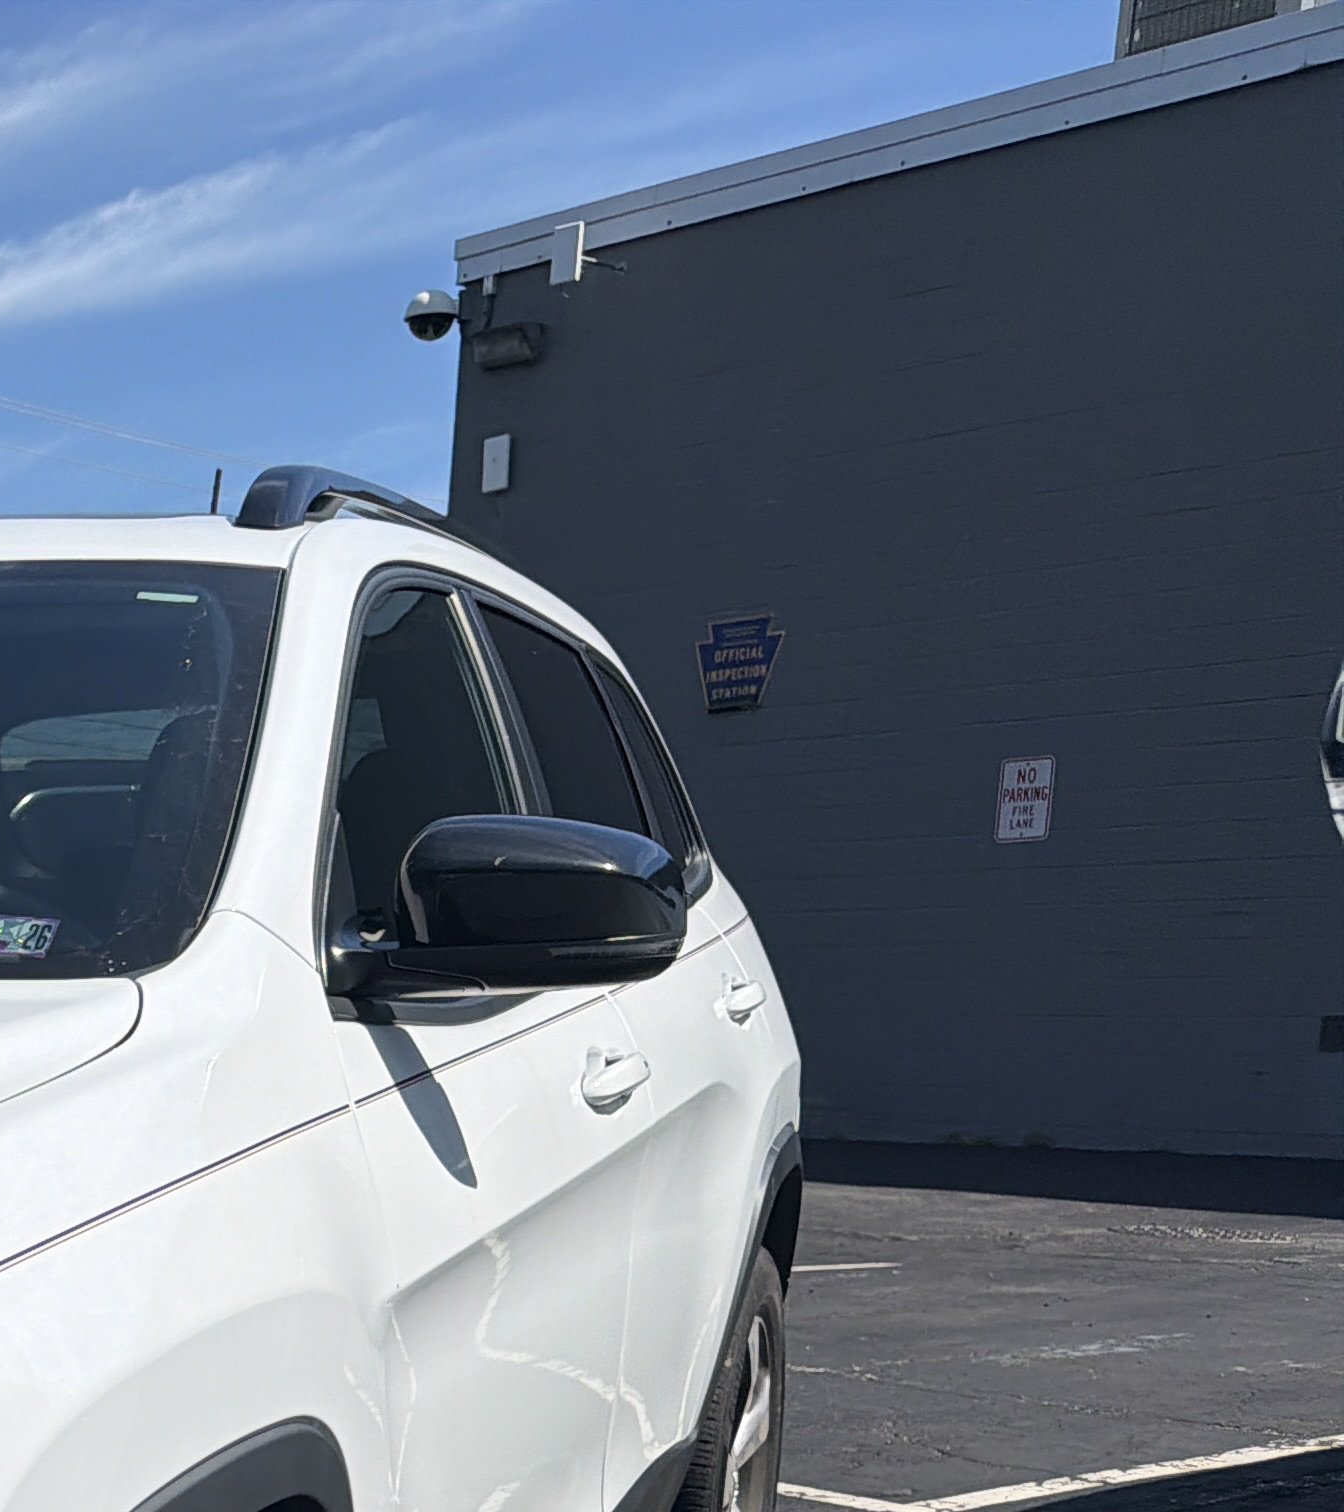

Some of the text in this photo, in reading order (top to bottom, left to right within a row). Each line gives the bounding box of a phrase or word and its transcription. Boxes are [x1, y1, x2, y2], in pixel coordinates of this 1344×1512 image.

[714, 645, 764, 663] OFFICIAL
[705, 664, 768, 683] INSPECTION
[711, 684, 758, 700] STATION
[1016, 767, 1037, 784] NO
[1002, 786, 1049, 803] PARKING
[1011, 804, 1035, 817] FIRE
[1009, 818, 1035, 830] LANE
[22, 923, 53, 950] 26
